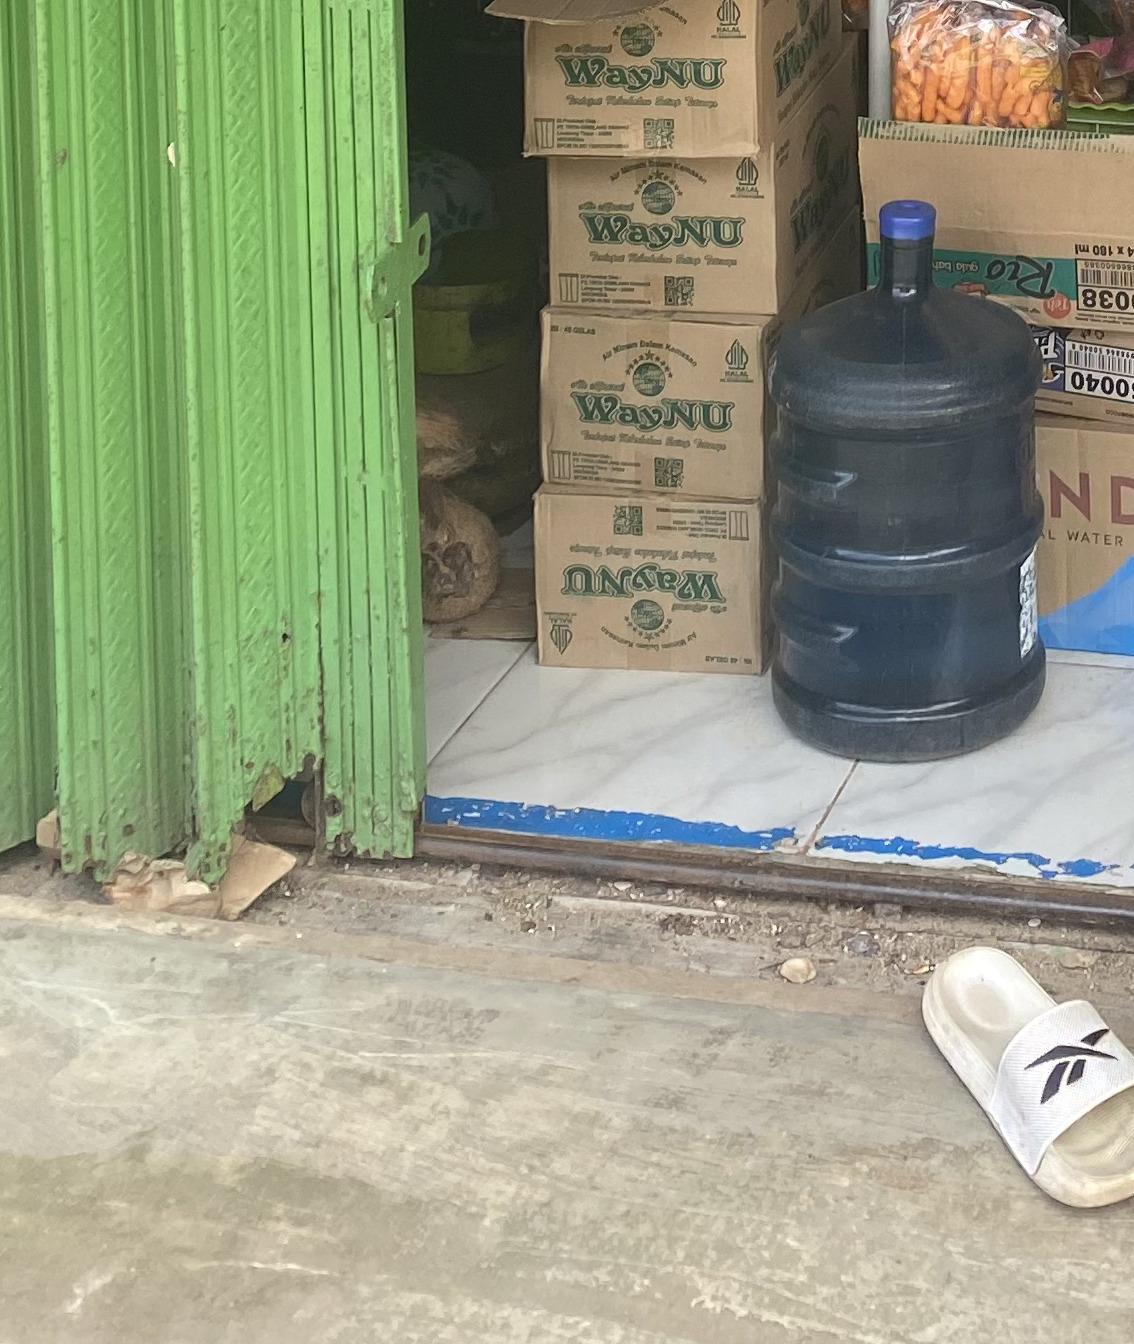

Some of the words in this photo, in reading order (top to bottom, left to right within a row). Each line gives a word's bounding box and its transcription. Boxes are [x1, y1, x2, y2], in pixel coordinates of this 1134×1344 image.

[555, 55, 727, 94] WayNU
[578, 212, 746, 252] WayNU
[1074, 243, 1090, 255] ml
[954, 261, 979, 274] gula
[981, 255, 1056, 300] Rio
[570, 391, 736, 432] WayNU
[1066, 530, 1124, 547] WATER
[560, 562, 727, 604] WayNU
